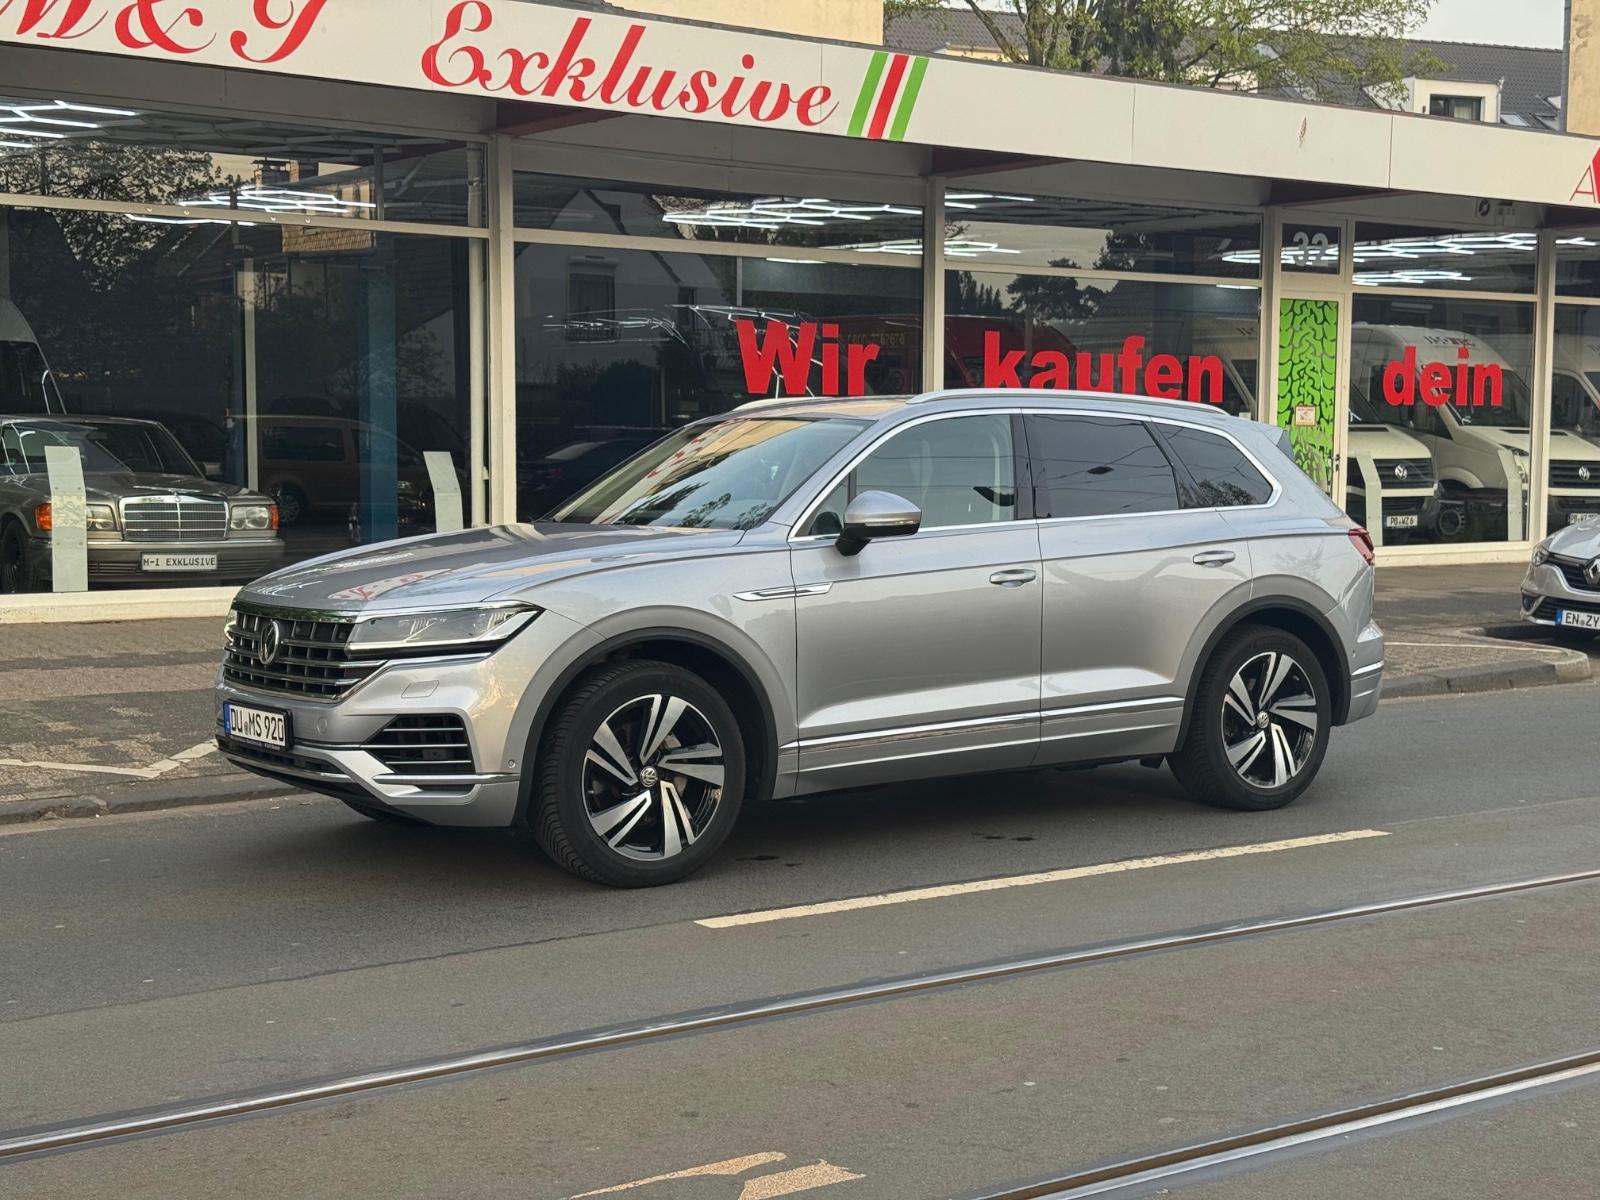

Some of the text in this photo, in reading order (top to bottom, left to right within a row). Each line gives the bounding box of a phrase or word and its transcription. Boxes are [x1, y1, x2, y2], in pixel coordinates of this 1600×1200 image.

[421, 0, 840, 127] Exklusive
[736, 319, 1503, 407] Wir kaufen dein
[165, 556, 216, 567] EXKLUSIVE
[1565, 612, 1580, 625] EN
